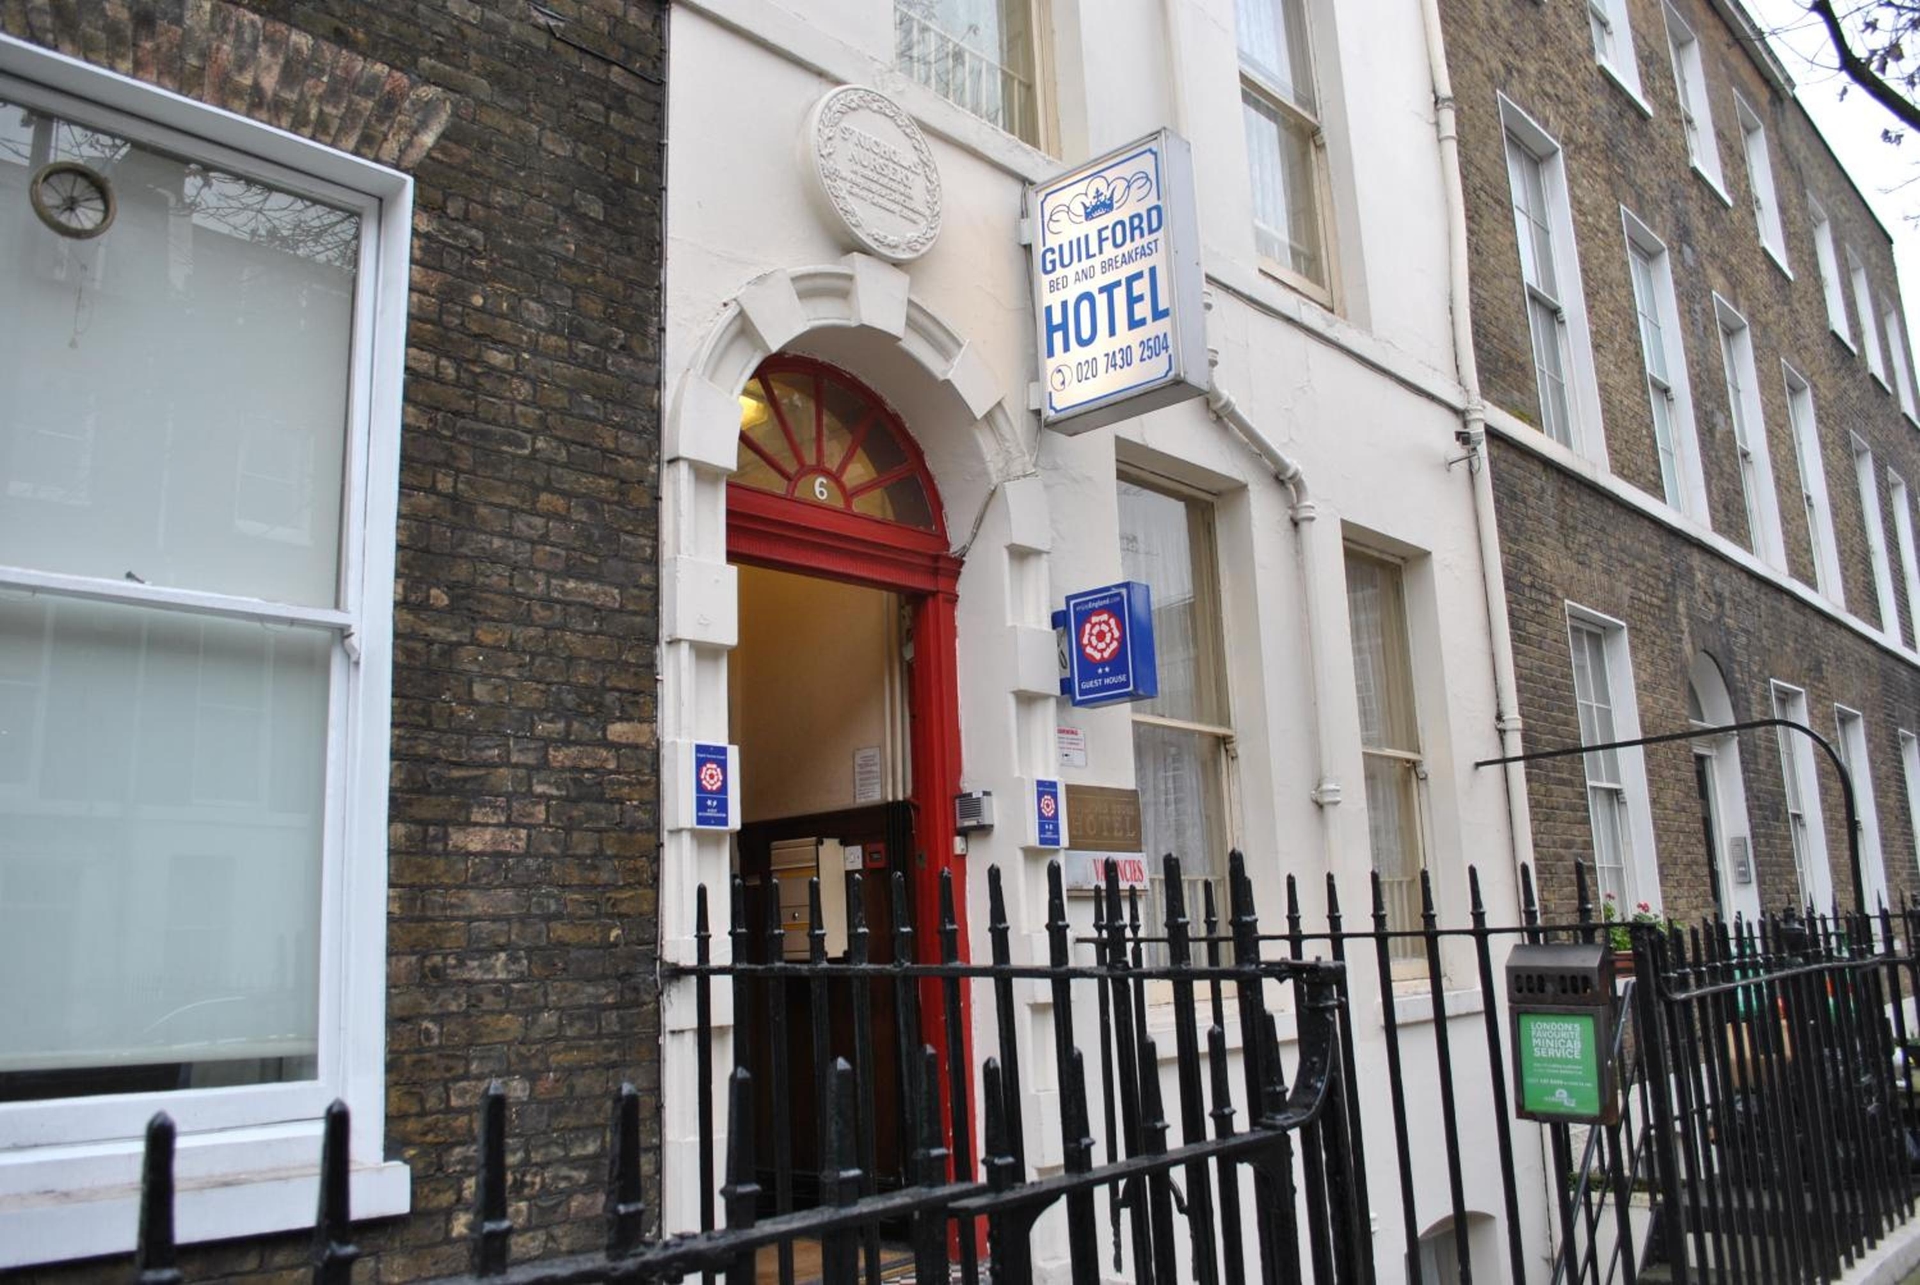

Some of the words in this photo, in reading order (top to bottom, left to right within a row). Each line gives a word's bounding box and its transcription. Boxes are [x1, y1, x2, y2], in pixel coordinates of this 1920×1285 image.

[848, 151, 913, 190] NURSERY
[1041, 203, 1163, 275] GUILFORD
[1049, 275, 1068, 293] BED
[1074, 264, 1096, 285] AND
[1101, 237, 1160, 276] BREAKFAST
[1044, 265, 1170, 359] HOTEL
[1076, 356, 1098, 384] 020
[1104, 343, 1133, 374] 7430
[1139, 332, 1170, 363] 2504
[813, 476, 828, 501] 6
[1081, 678, 1102, 690] GUEST
[1104, 673, 1128, 686] HOUSE
[1071, 815, 1138, 837] HOTEL
[1092, 858, 1144, 882] VANCIES
[1531, 1022, 1580, 1031] LONDON'S
[1531, 1030, 1580, 1040] FAVOURITE
[1532, 1038, 1581, 1050] MINICAB
[1534, 1047, 1581, 1059] SERVICE
